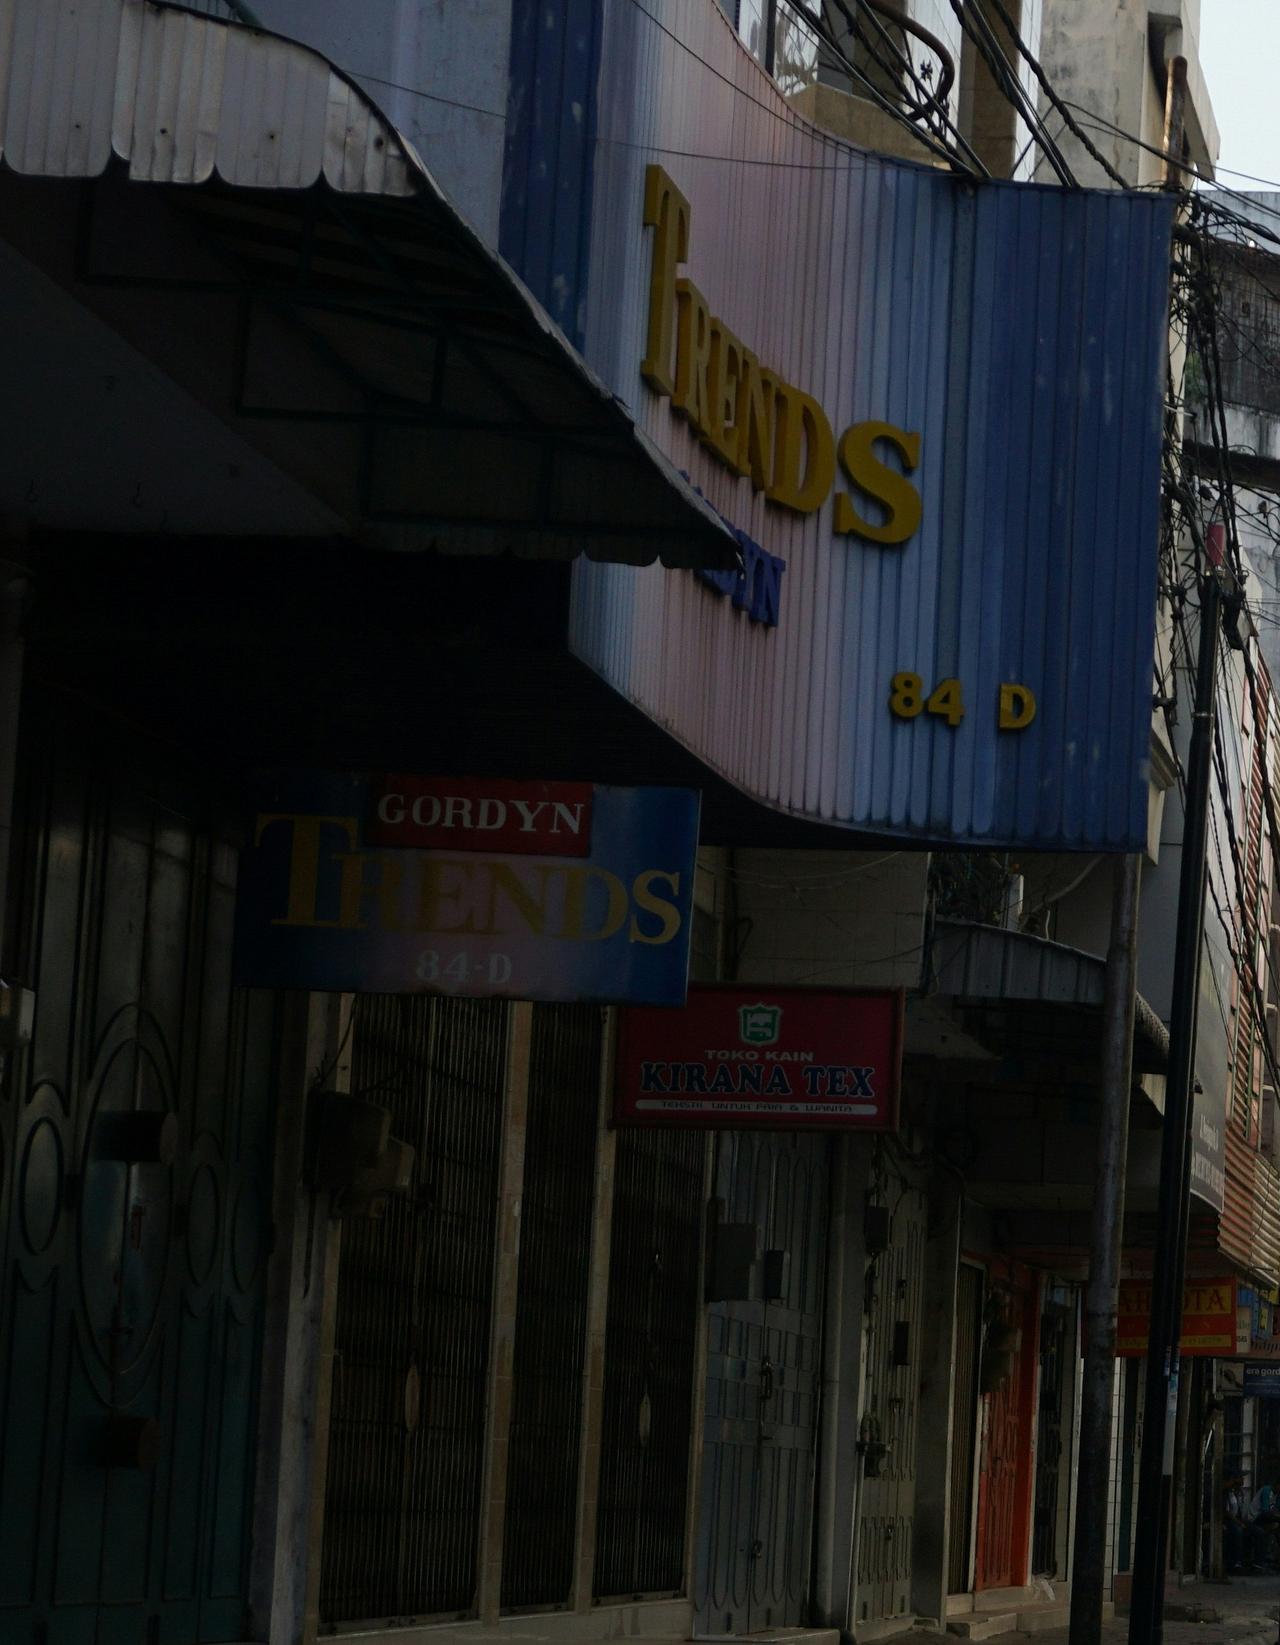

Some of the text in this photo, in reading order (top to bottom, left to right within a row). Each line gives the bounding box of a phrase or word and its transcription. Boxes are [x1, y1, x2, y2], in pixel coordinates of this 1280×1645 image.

[640, 164, 922, 544] TRENDS
[890, 672, 1036, 730] 84 D
[376, 792, 585, 834] GORDYN
[254, 811, 683, 945] TRENDS
[639, 1061, 876, 1099] KIRANA TEX
[704, 1049, 815, 1062] TOKO KAIN
